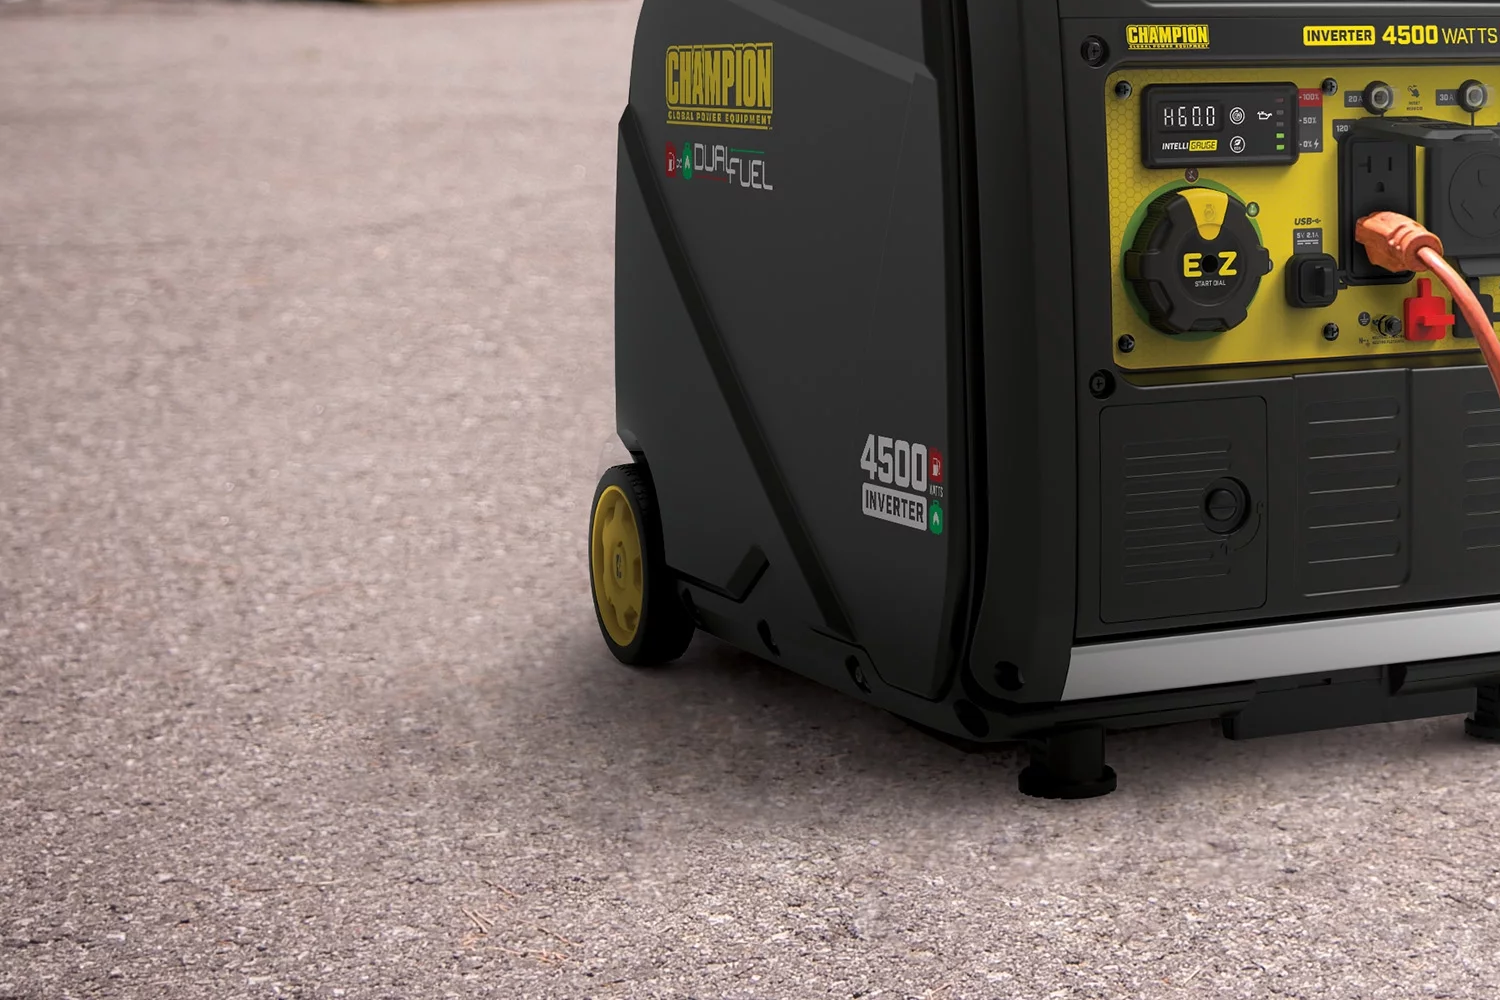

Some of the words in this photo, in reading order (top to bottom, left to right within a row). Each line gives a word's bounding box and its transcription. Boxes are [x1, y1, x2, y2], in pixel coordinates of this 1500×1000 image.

[1128, 26, 1208, 43] CHAMPION
[1307, 29, 1372, 42] INVERTER
[1382, 25, 1438, 45] 4500
[1442, 27, 1498, 43] WATTS
[667, 48, 771, 108] CHAMPION
[668, 111, 694, 121] GLOBAL
[696, 112, 722, 123] POWER
[725, 113, 772, 125] EQUIPMENT
[694, 143, 735, 174] DUAL
[728, 158, 773, 190] FUEL
[1294, 218, 1312, 226] USB
[1213, 279, 1226, 287] DIAL
[860, 434, 927, 492] 4500
[865, 489, 924, 523] INVERTER
